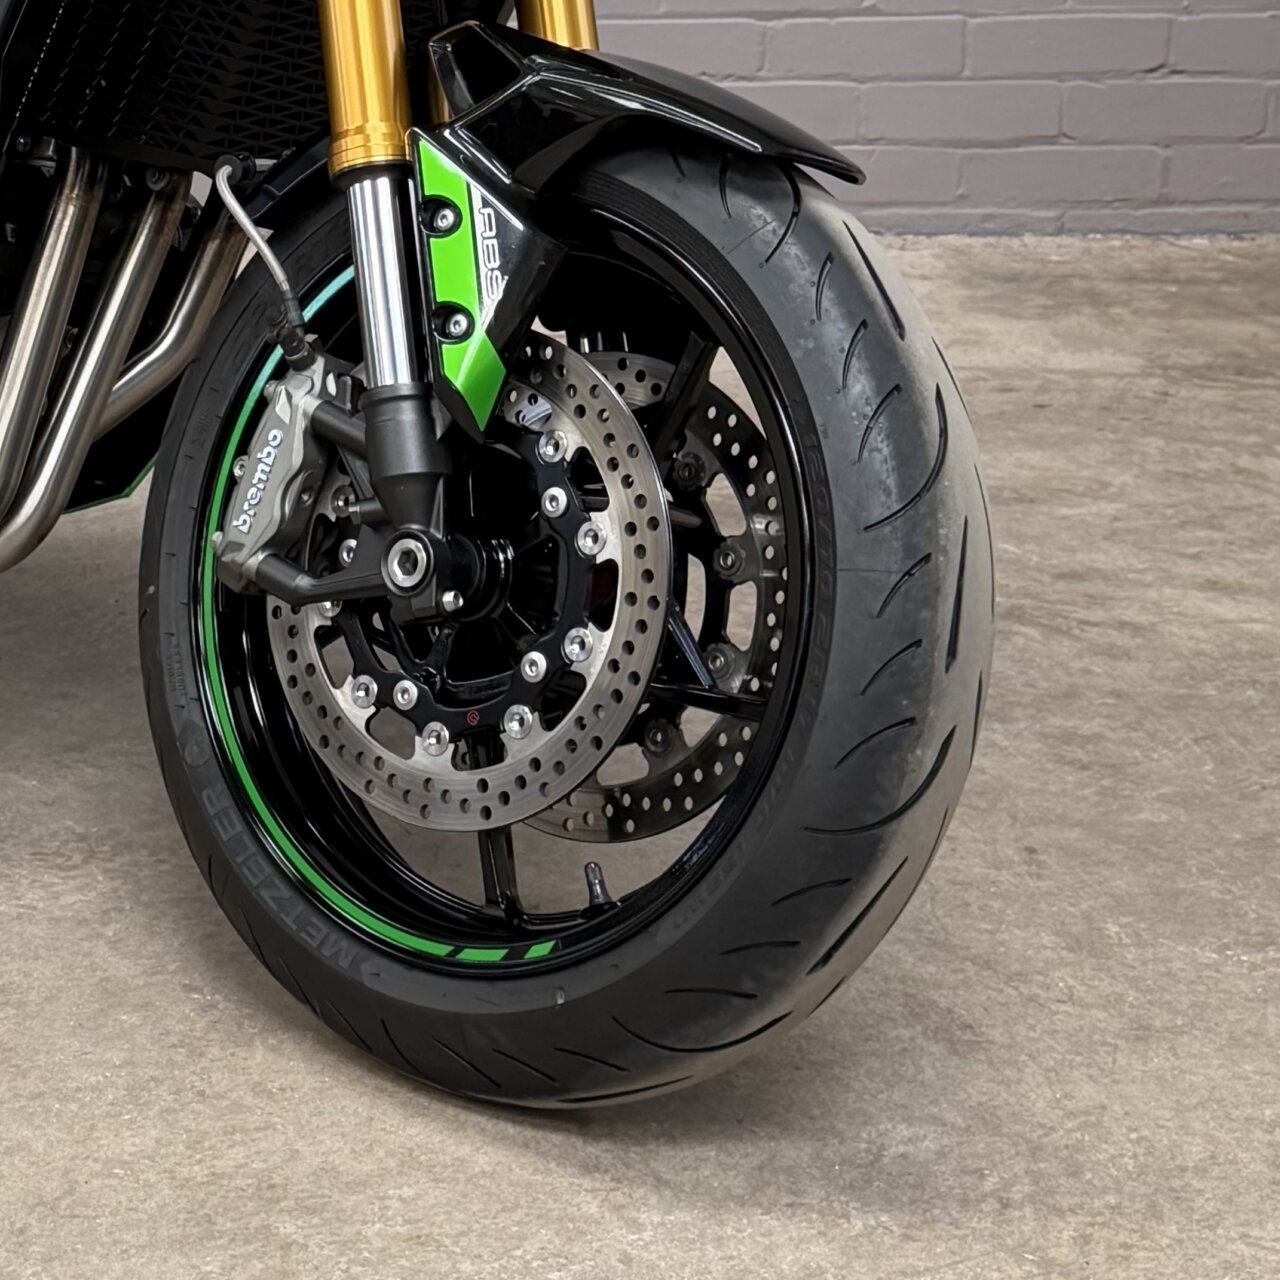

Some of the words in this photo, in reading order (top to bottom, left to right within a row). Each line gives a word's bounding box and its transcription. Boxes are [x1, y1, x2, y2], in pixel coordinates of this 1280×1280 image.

[478, 207, 509, 302] ABS
[232, 428, 284, 535] brembo
[202, 785, 355, 970] METZELER
